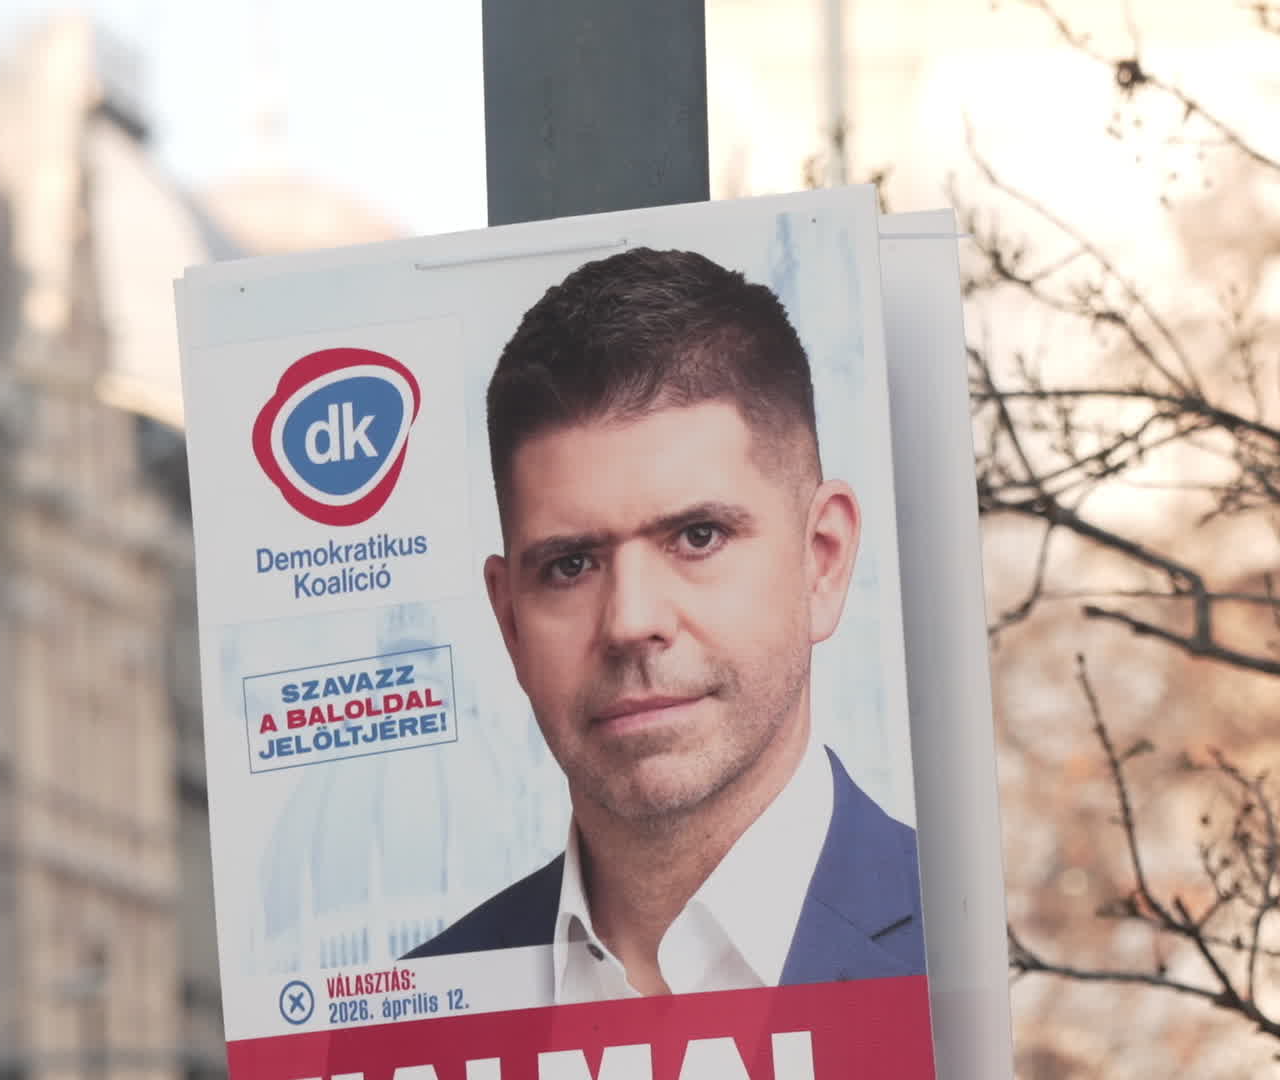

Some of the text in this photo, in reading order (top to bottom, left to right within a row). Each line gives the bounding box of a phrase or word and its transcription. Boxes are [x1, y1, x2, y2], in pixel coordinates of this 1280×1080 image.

[305, 402, 378, 464] dk
[256, 534, 427, 573] Demokratikus
[294, 563, 391, 599] Koalíció
[281, 665, 415, 704] SZAVAZZ
[259, 688, 442, 734] A BALOLDAL
[258, 712, 447, 760] JELÖLTJÉRE!
[327, 967, 416, 999] VÁLASZTÁS:
[328, 988, 470, 1024] 2026. április 12.
